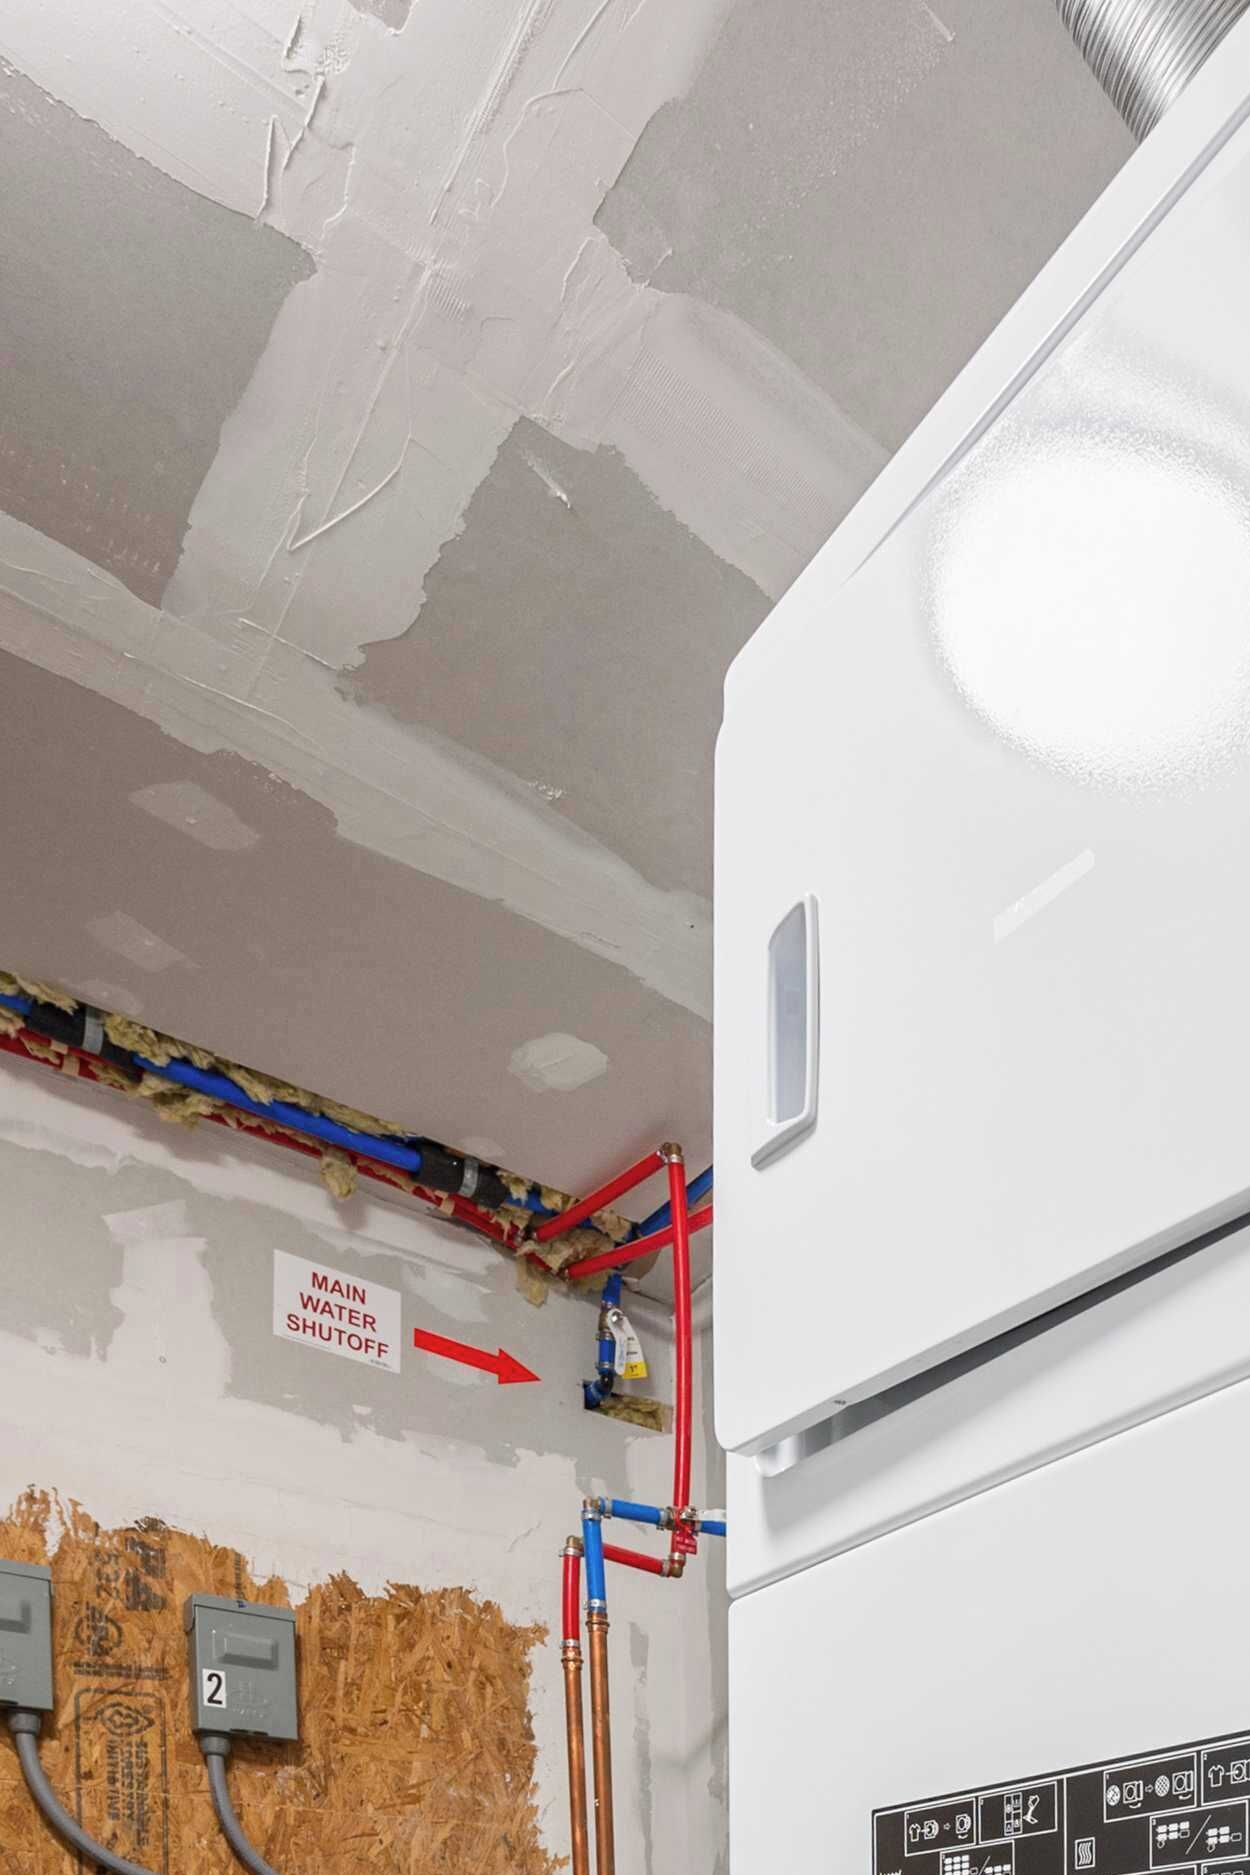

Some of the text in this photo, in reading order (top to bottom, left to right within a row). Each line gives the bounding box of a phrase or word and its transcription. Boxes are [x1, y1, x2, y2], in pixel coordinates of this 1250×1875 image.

[312, 1271, 366, 1305] MAIN
[299, 1291, 377, 1333] WATER
[286, 1313, 390, 1358] SHUTOFF
[206, 1672, 224, 1706] 2
